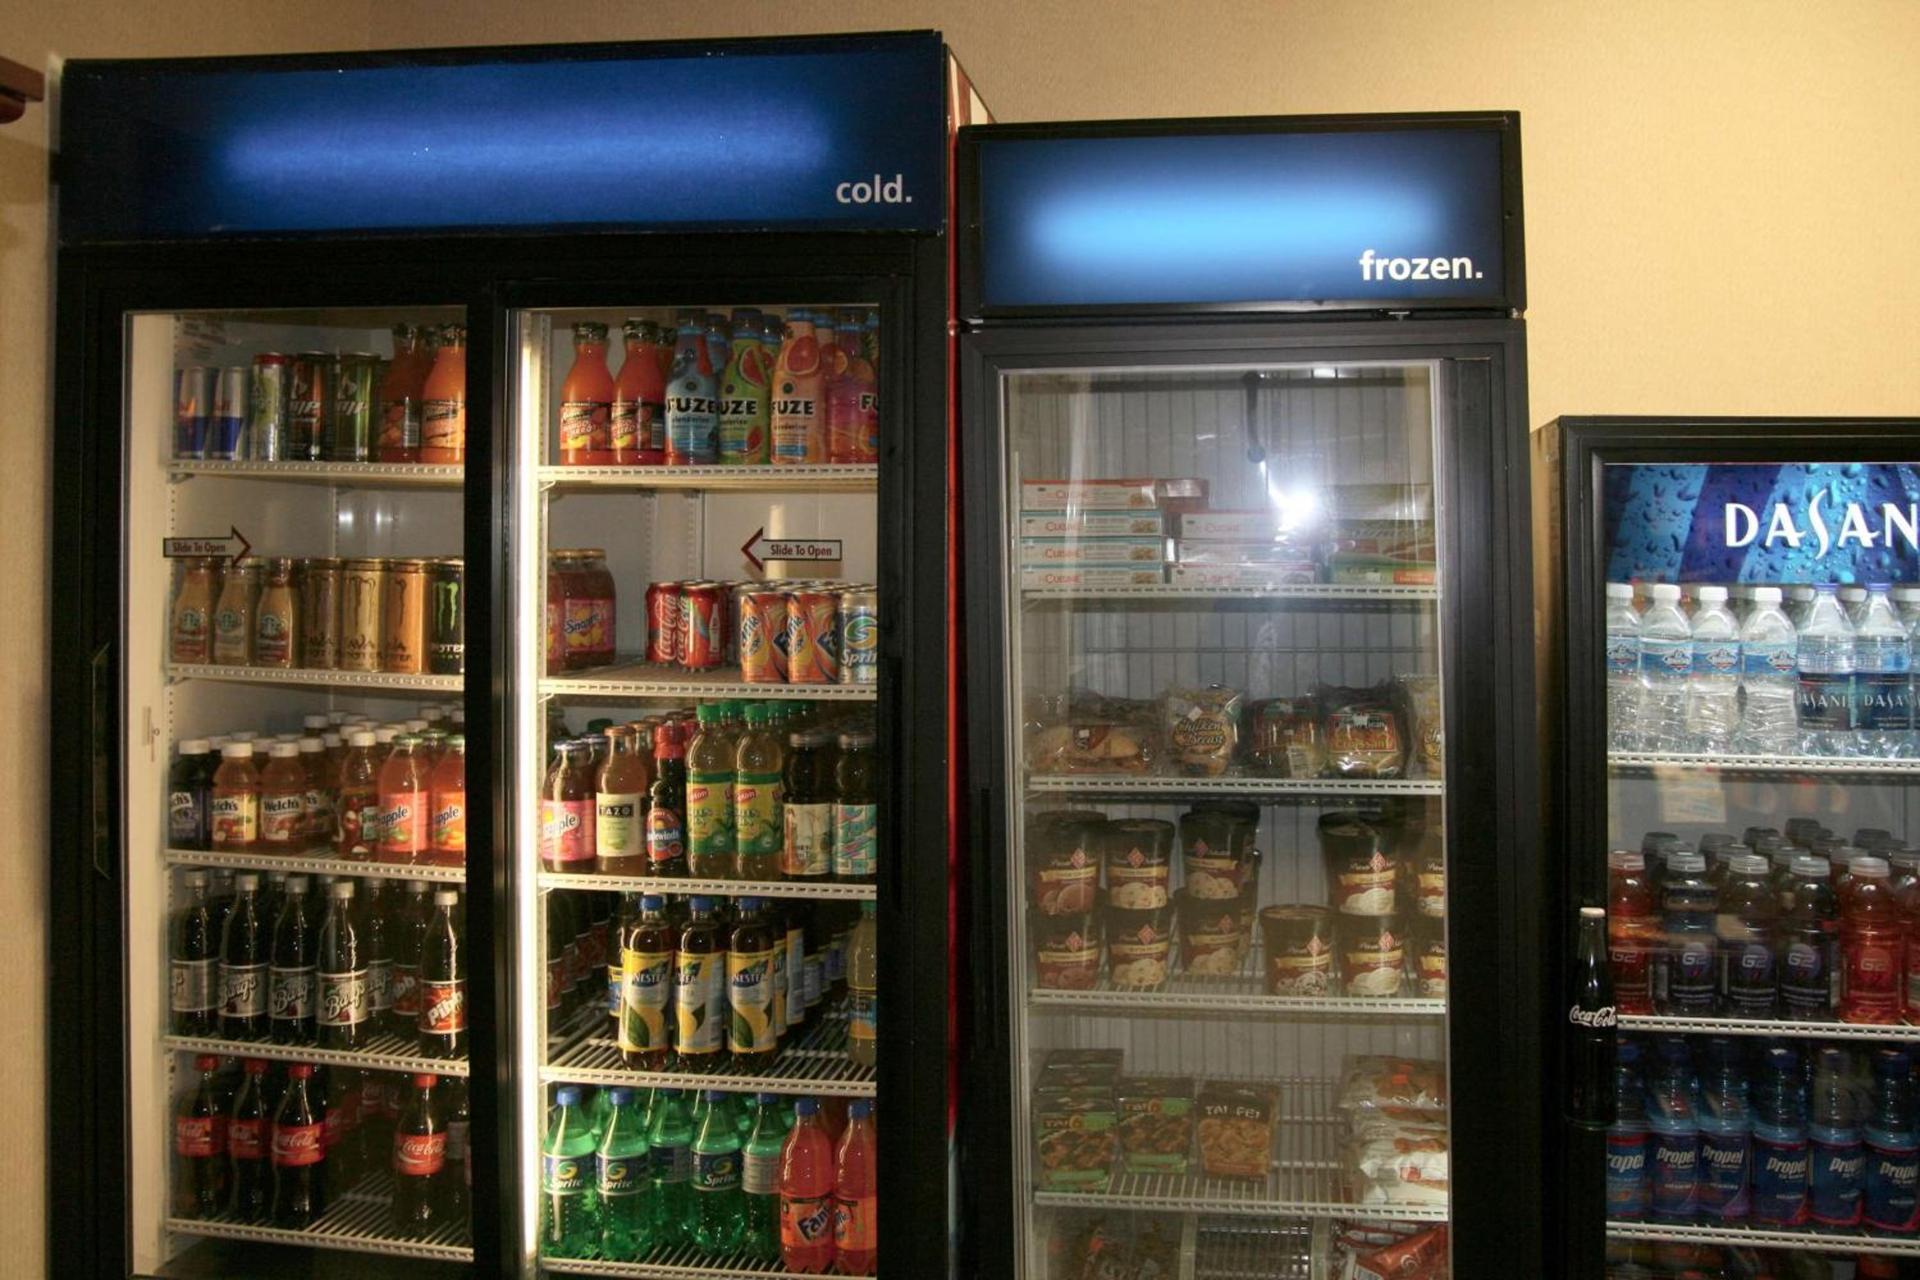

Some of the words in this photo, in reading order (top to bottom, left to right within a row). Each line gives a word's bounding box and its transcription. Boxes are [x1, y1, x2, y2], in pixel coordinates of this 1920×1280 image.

[836, 174, 912, 204] cold.
[1359, 249, 1484, 282] frozen.
[719, 400, 757, 415] UZE
[1724, 488, 1920, 561] DASAN
[770, 544, 793, 556] Slide
[795, 544, 806, 556] To
[808, 544, 833, 560] Open
[1802, 691, 1846, 709] ASANI
[1864, 691, 1904, 710] DASA
[264, 799, 300, 811] Welch's
[380, 805, 408, 826] apple
[1569, 1004, 1617, 1028] Coca-Cola
[1608, 1153, 1645, 1173] ropel
[1702, 1145, 1744, 1165] Propel
[1879, 1162, 1919, 1179] Prope
[704, 1174, 737, 1188] Sprite
[798, 1205, 833, 1241] Fan
